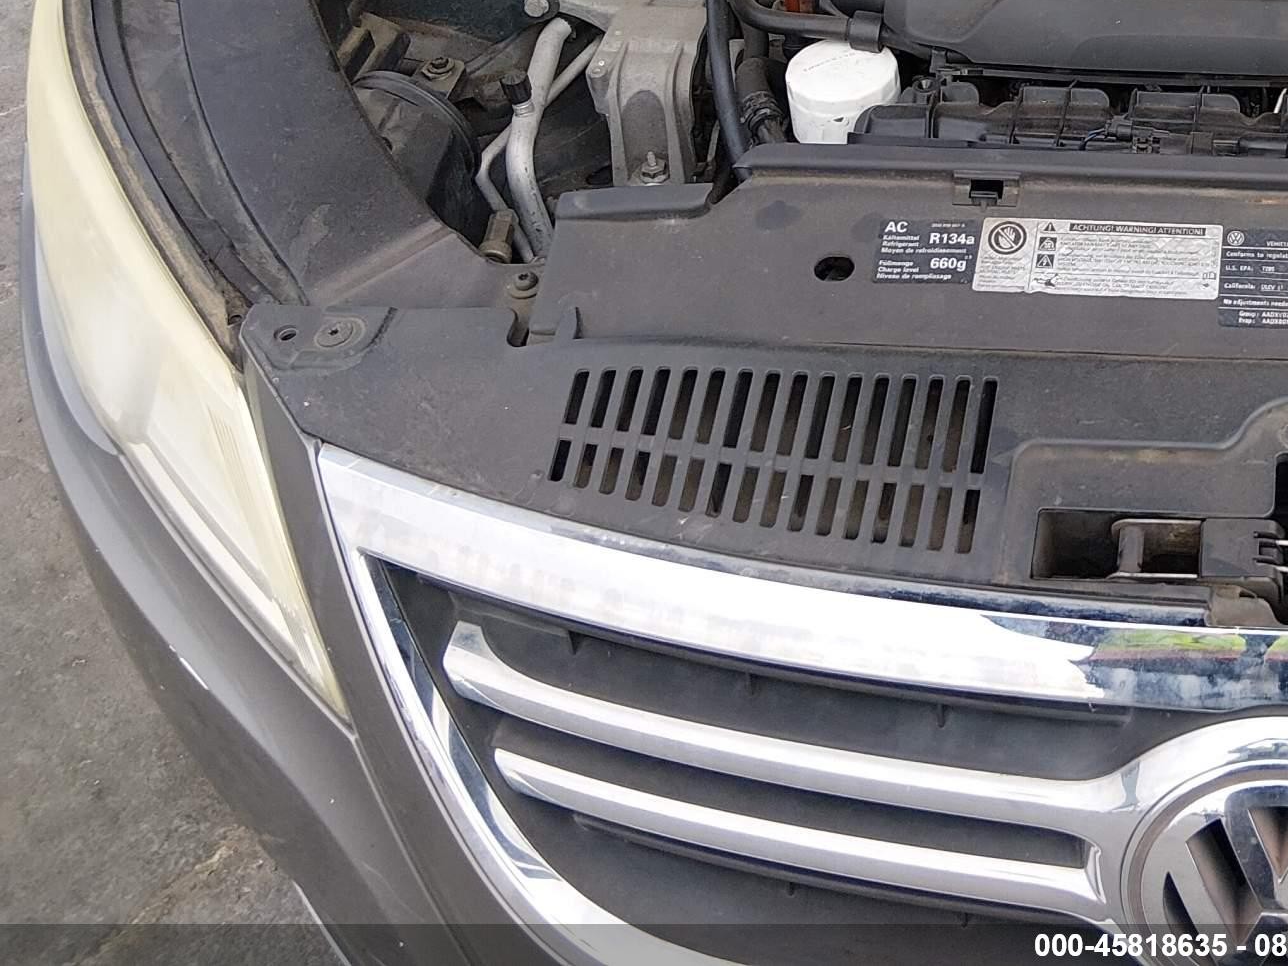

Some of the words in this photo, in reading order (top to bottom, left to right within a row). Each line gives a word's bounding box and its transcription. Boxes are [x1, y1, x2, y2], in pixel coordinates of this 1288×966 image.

[884, 221, 908, 233] AC
[1072, 224, 1115, 232] ACHTUNG!
[1115, 225, 1157, 233] WARNING!
[1157, 227, 1204, 235] ATTENTION!
[929, 232, 975, 245] R134a
[878, 266, 901, 274] Charge
[930, 257, 967, 272] 660g
